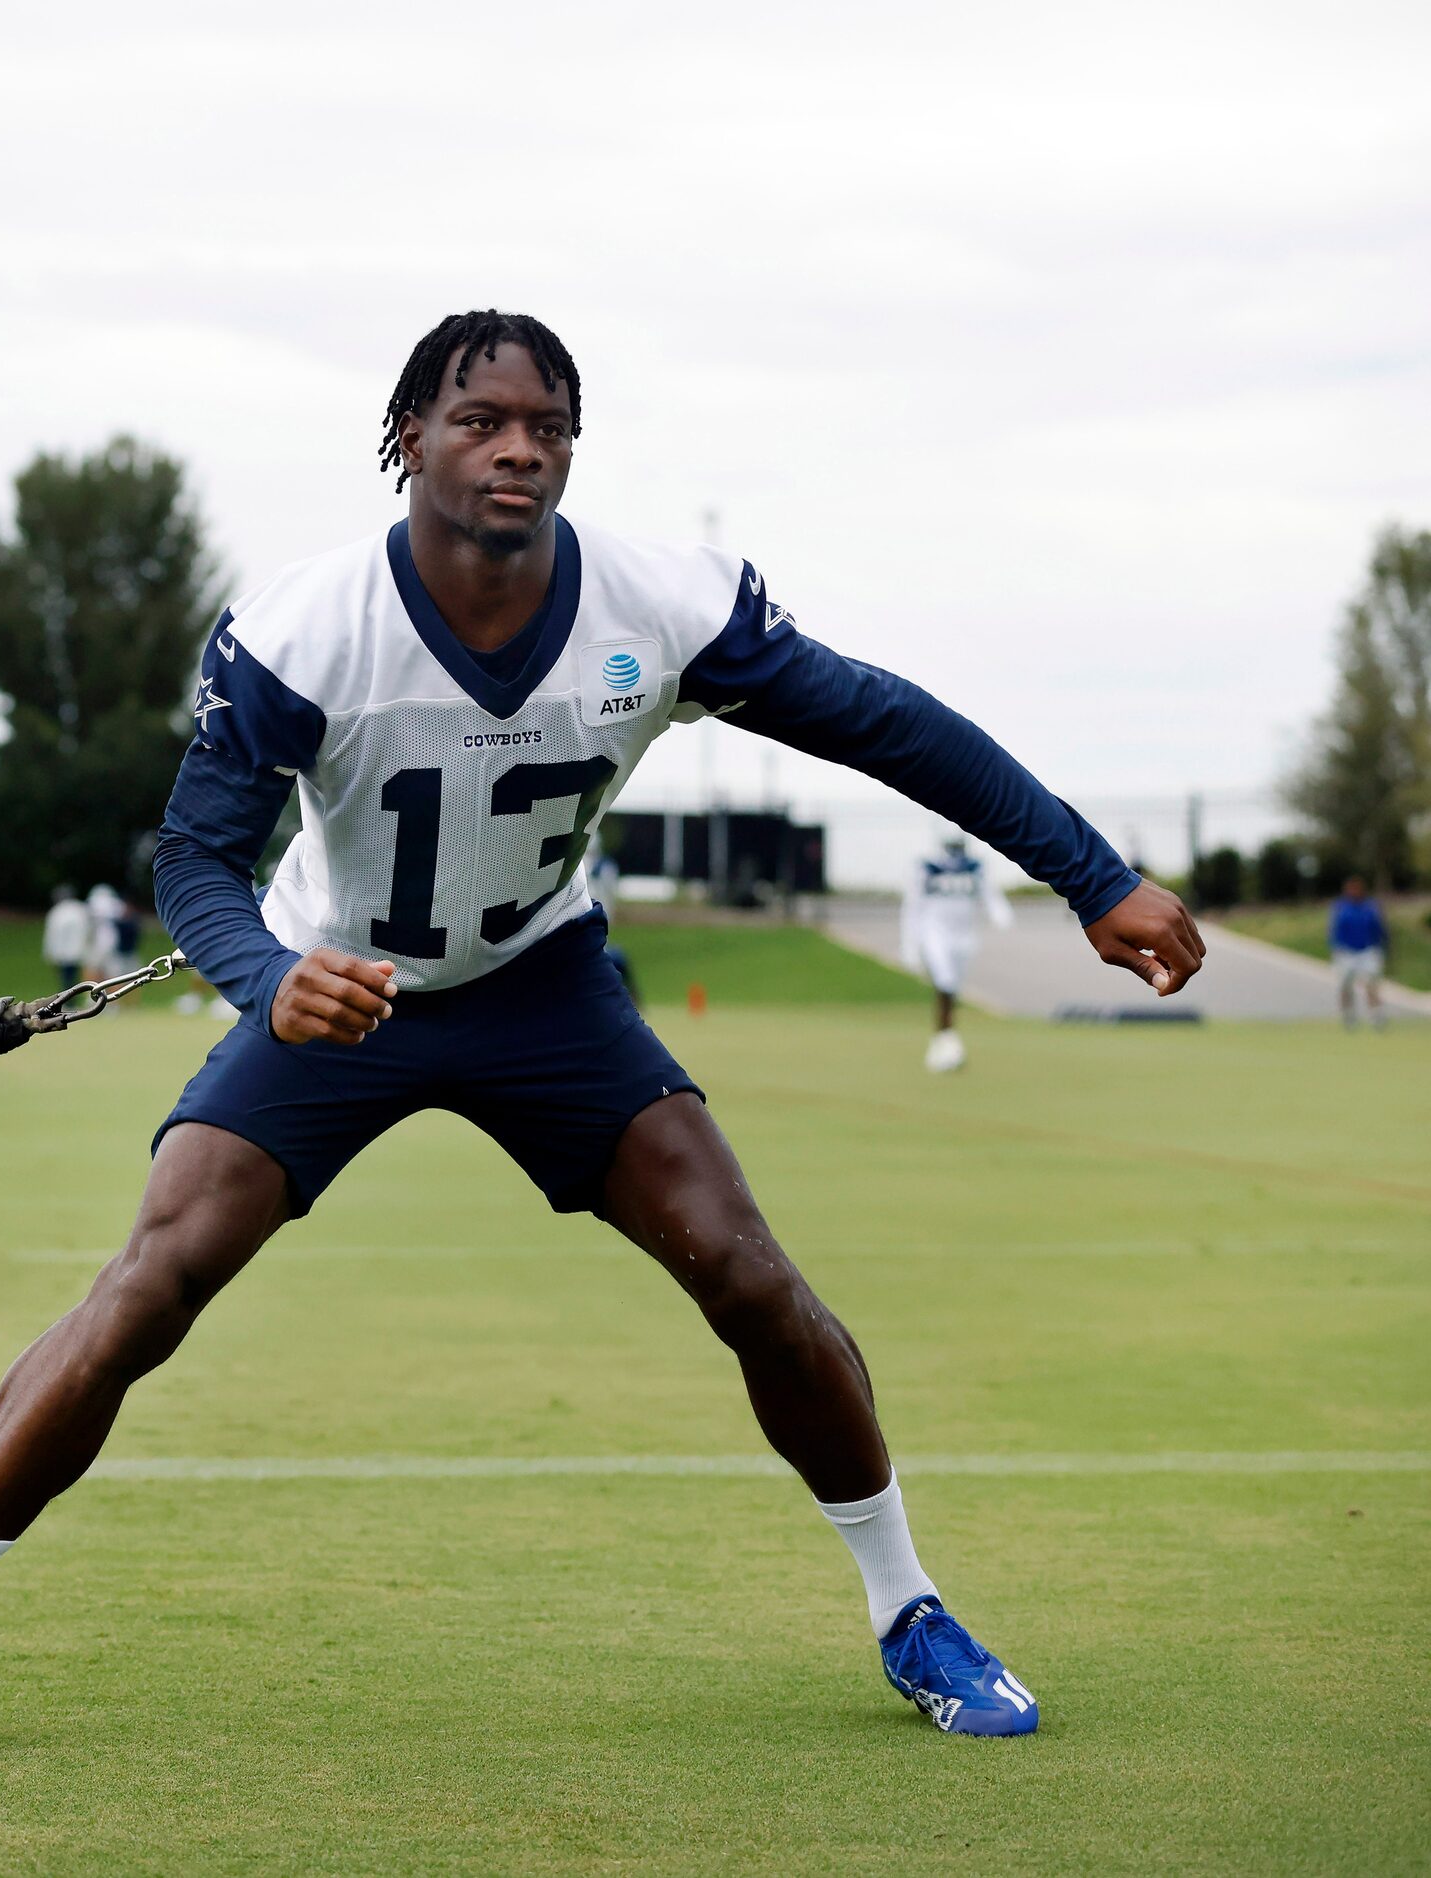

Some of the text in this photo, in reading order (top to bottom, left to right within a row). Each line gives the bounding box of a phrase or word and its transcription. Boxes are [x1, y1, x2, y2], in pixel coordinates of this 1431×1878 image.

[600, 694, 646, 716] AT&T
[463, 730, 543, 748] COWBOYS
[370, 754, 619, 959] 13
